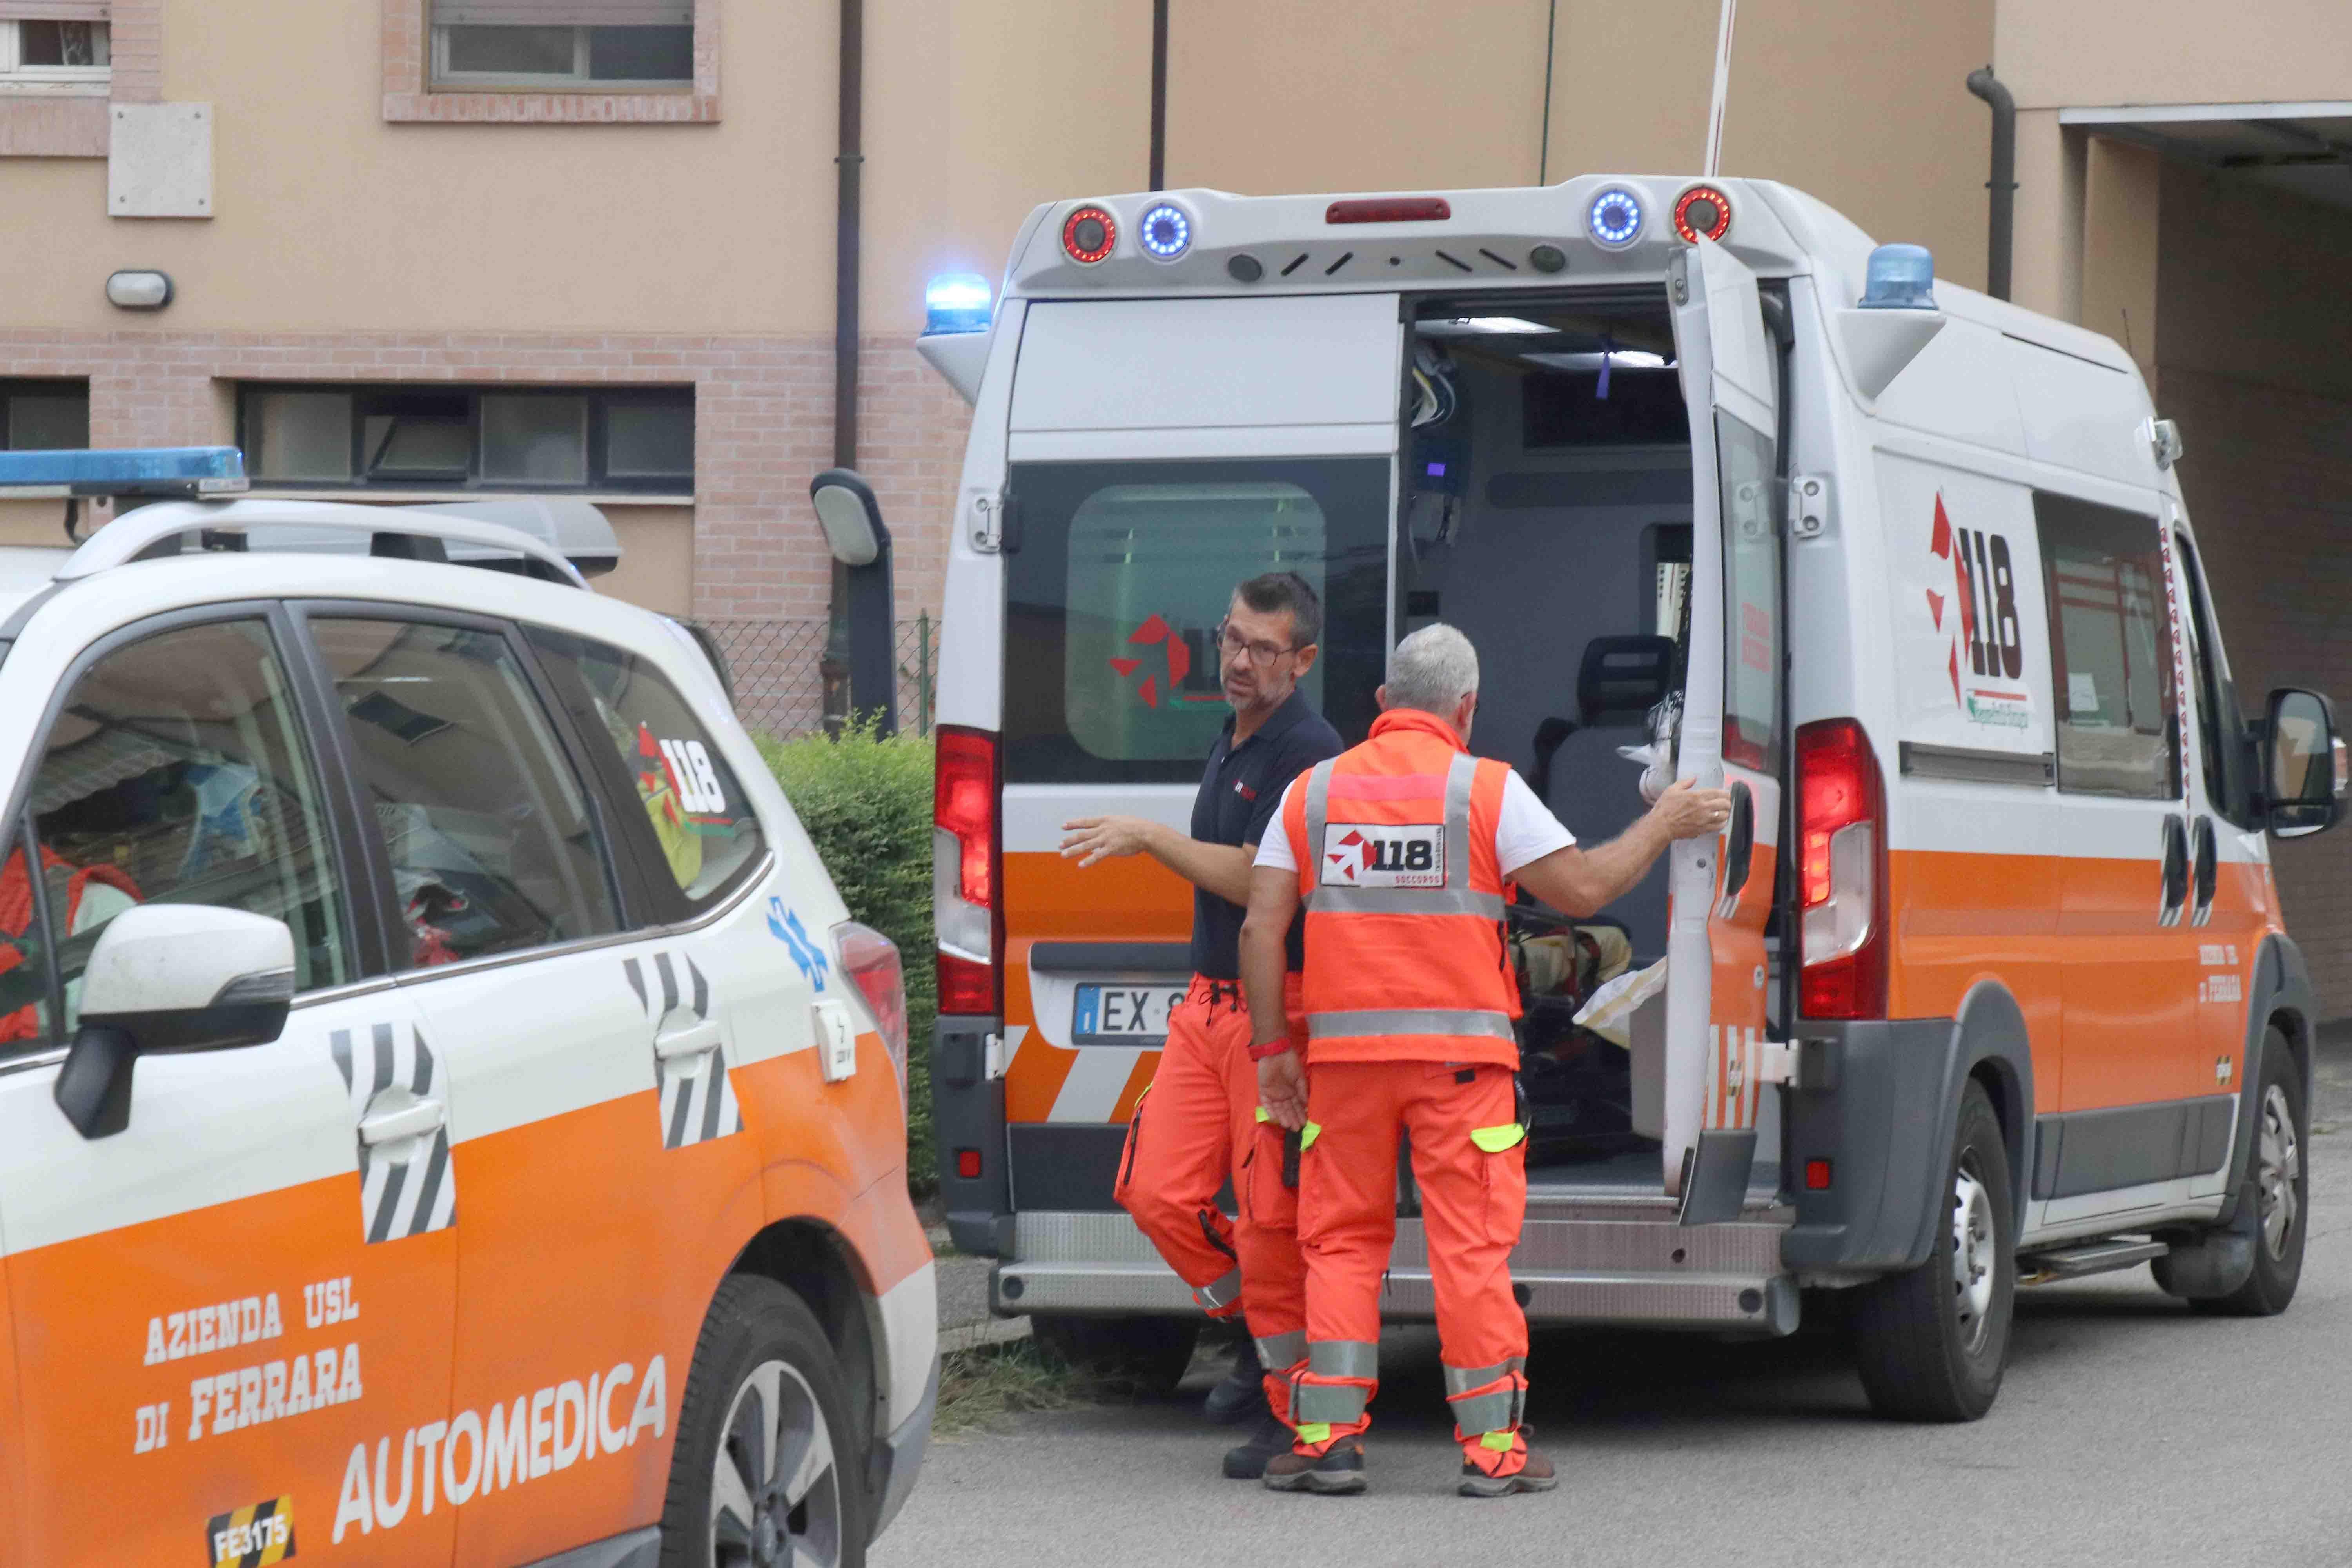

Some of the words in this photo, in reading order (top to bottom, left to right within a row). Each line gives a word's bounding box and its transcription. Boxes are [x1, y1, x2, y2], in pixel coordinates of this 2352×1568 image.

[1959, 527, 2022, 680] 118
[659, 739, 726, 813] 118
[1372, 840, 1432, 871] 118
[143, 1292, 283, 1367] AZIENDA
[304, 1276, 359, 1329] USL
[134, 1401, 169, 1455] DI
[188, 1342, 363, 1441] FERRARA
[332, 1354, 667, 1545] AUTOMEDICA
[214, 1514, 287, 1562] FE3175
